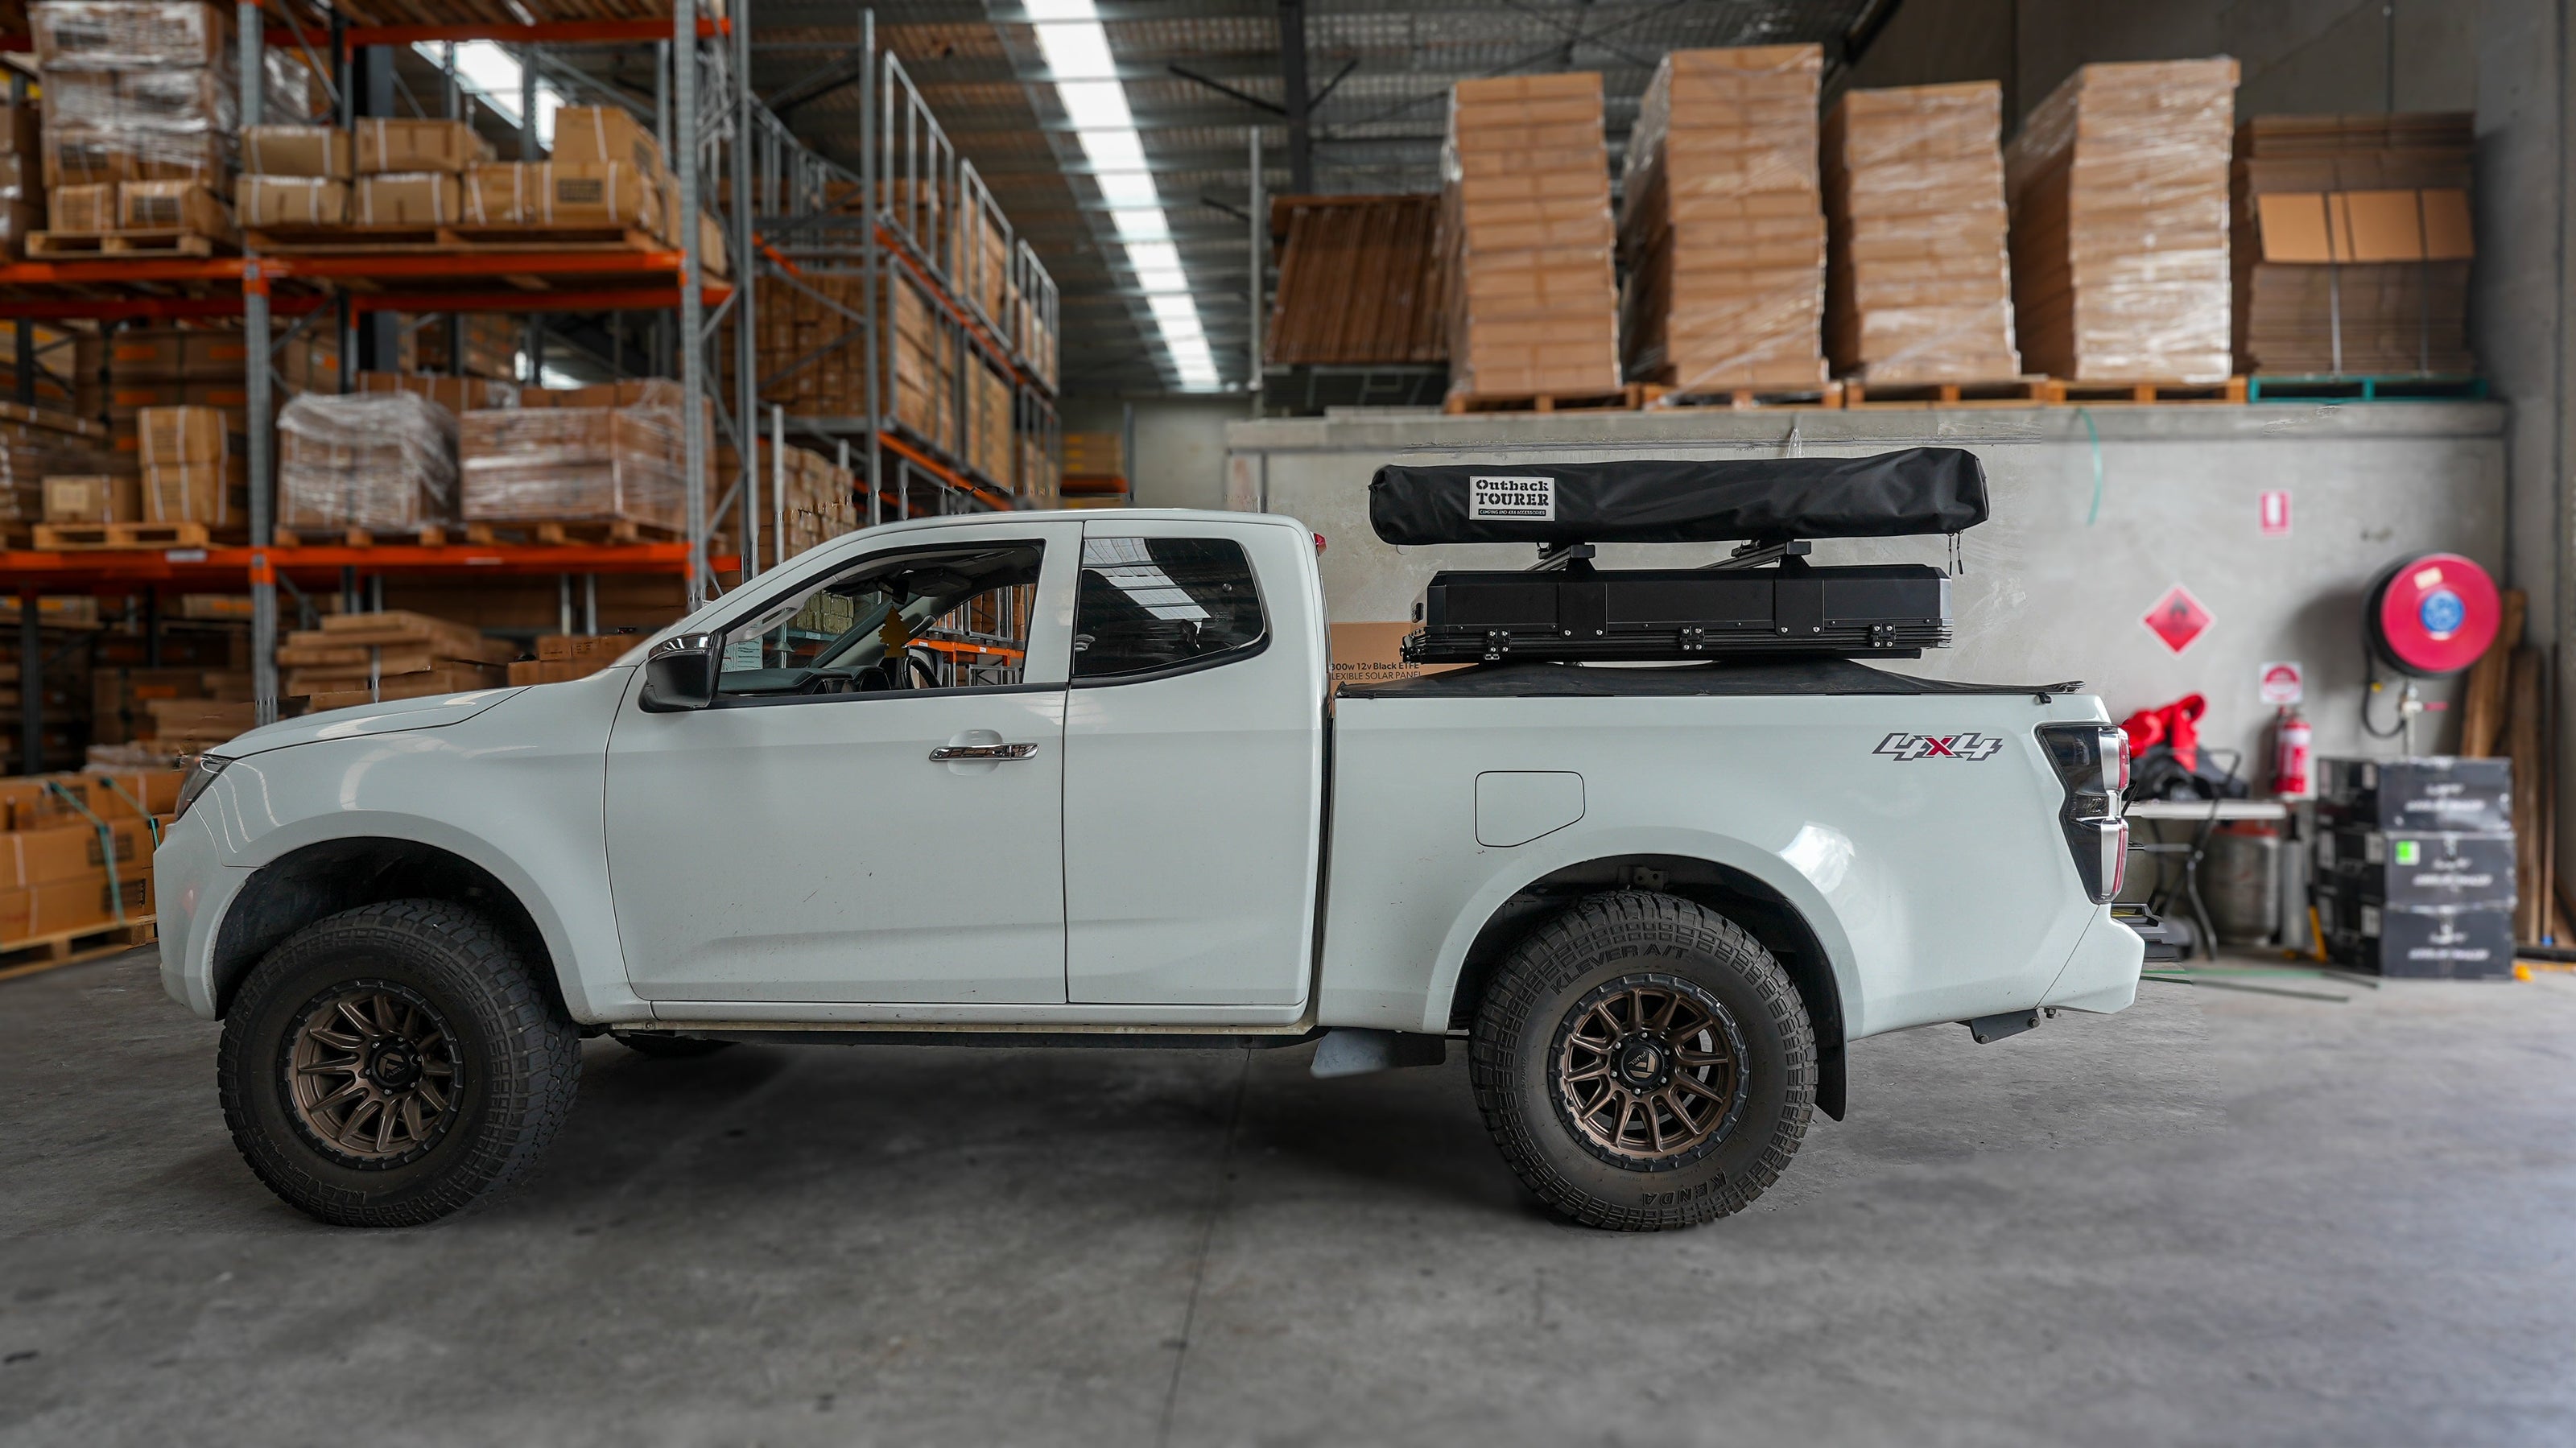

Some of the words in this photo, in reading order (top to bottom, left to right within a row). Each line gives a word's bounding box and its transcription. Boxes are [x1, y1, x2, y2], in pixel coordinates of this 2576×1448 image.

[1476, 479, 1549, 491] Outback
[1476, 493, 1549, 505] TOURER
[1373, 662, 1397, 670] Black
[1550, 944, 1639, 996] KLEVER
[1643, 943, 1689, 959] A/T
[1642, 1166, 1728, 1207] KENDA
